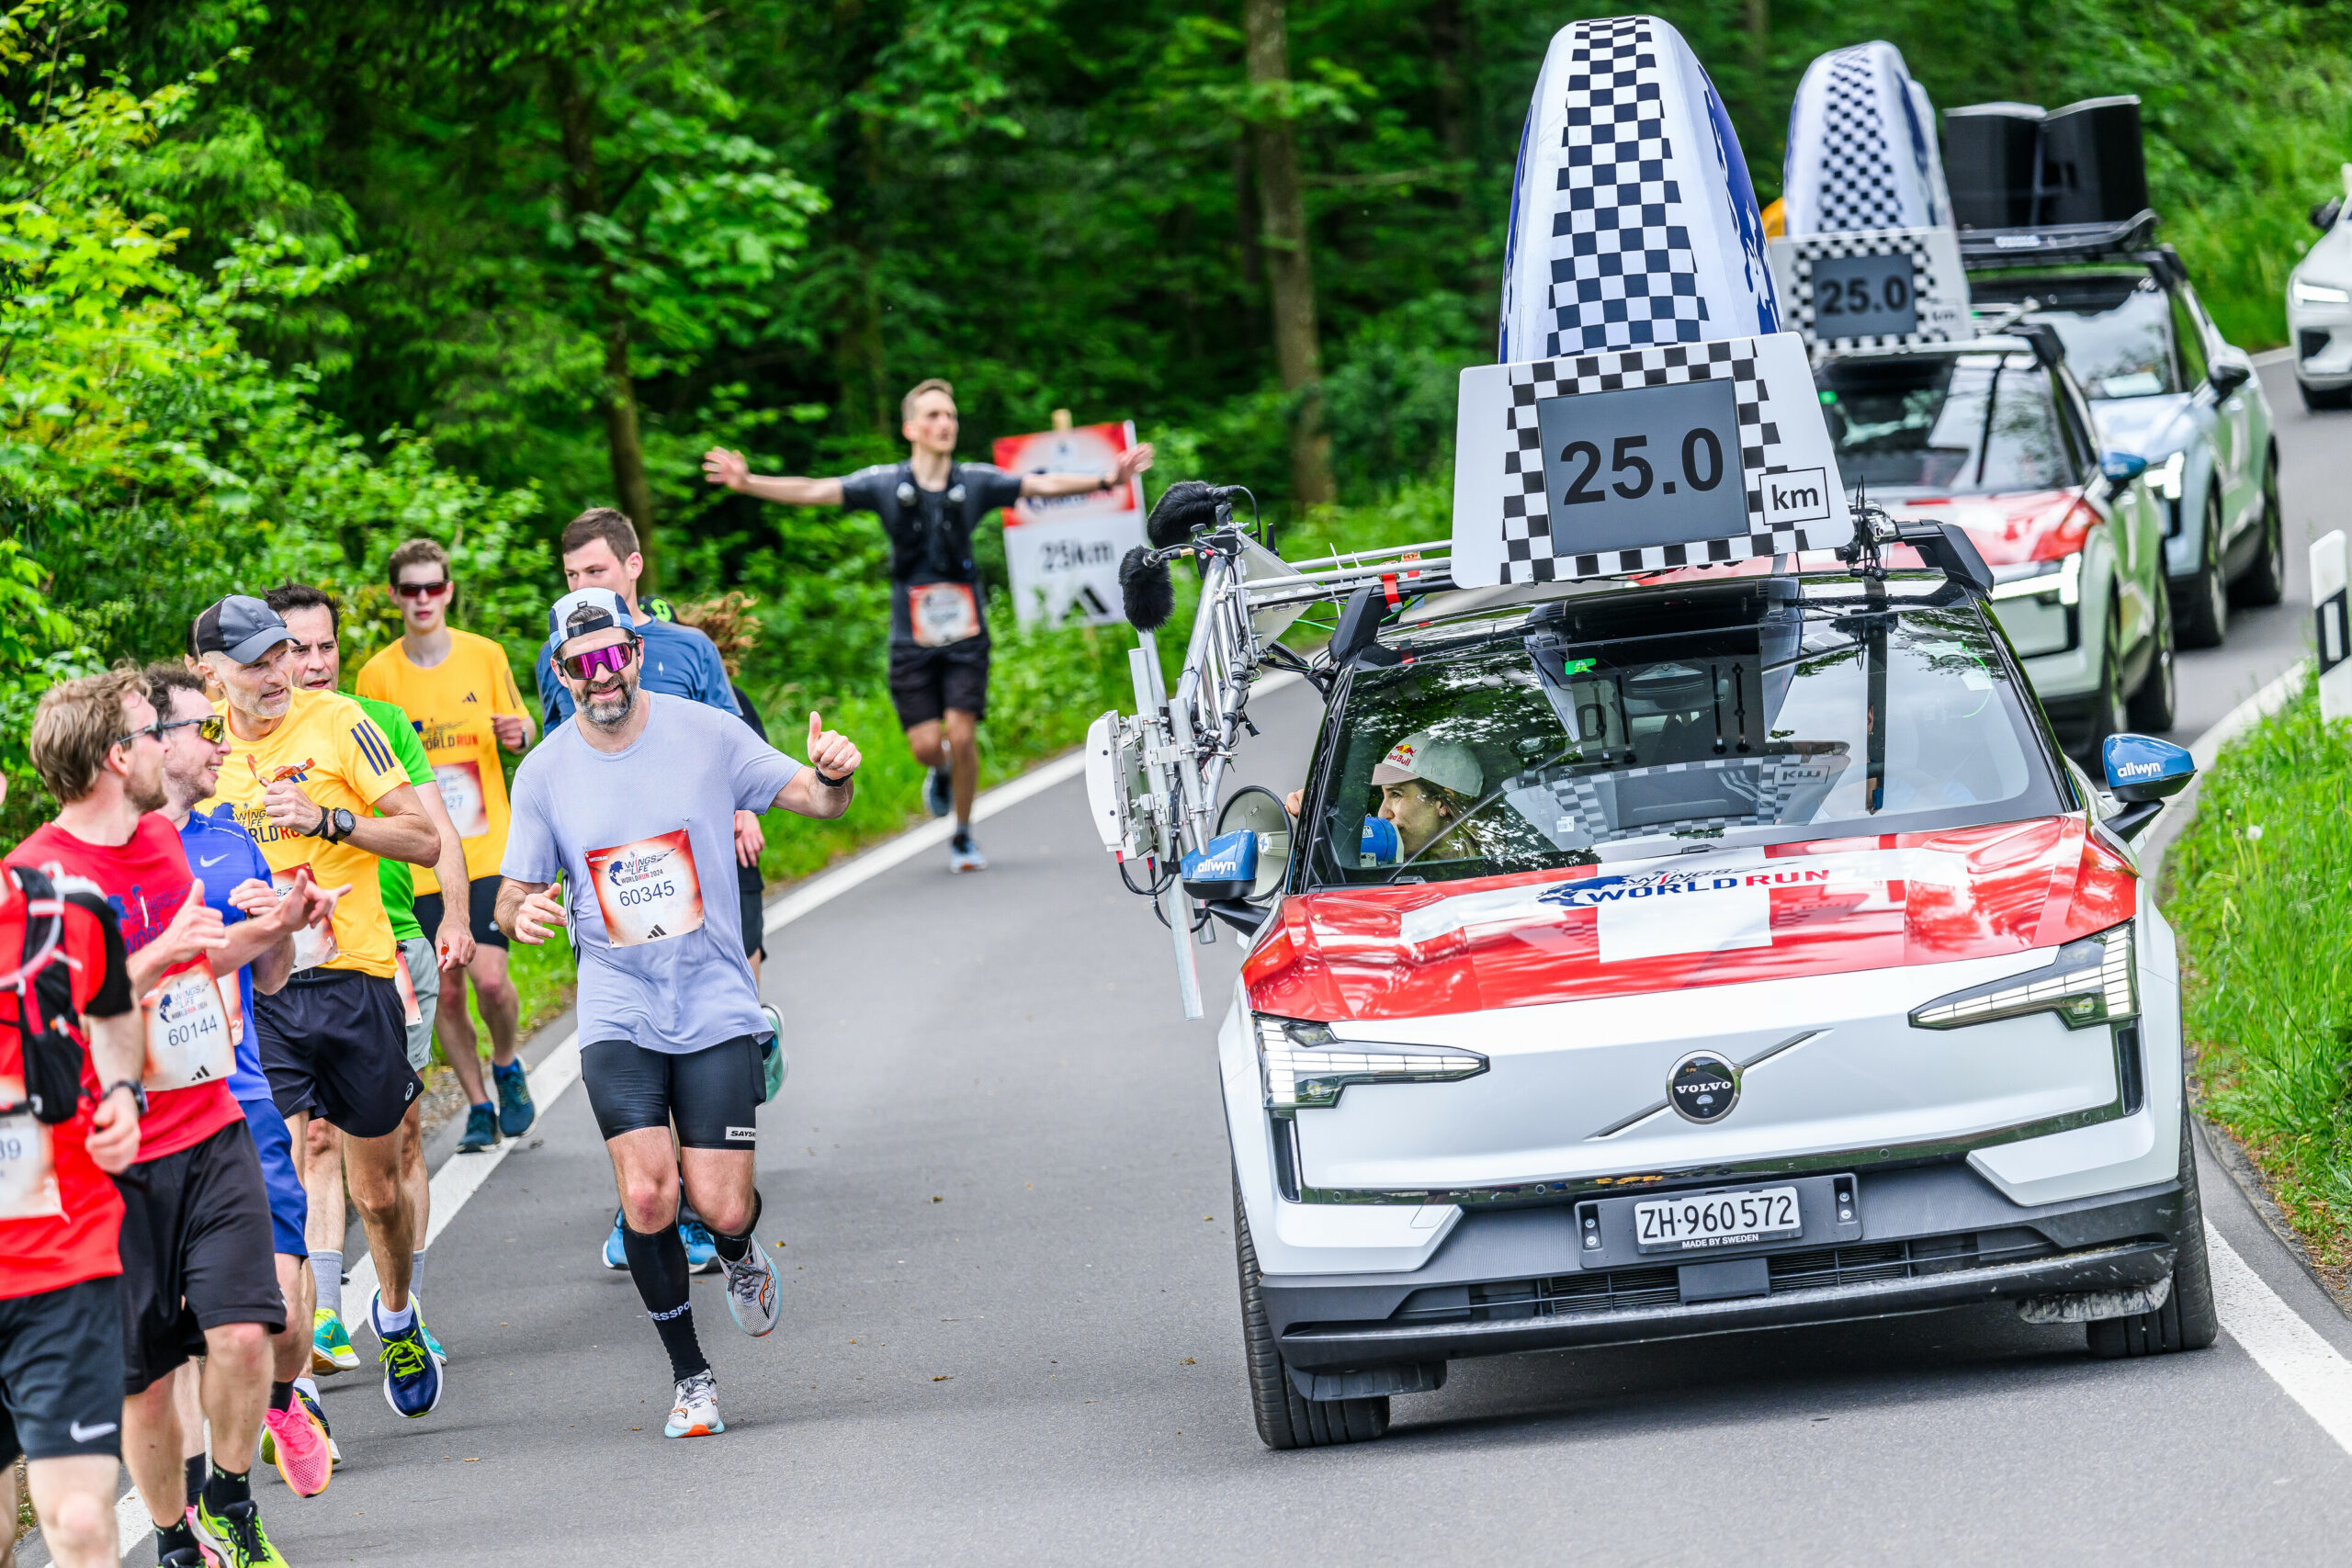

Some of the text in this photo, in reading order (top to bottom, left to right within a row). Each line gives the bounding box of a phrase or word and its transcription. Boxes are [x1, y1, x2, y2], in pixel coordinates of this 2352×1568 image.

[1818, 275, 1908, 317] 25.0
[1560, 427, 1724, 505] 25.0
[1770, 483, 1819, 511] km
[2117, 761, 2161, 778] allwyn
[234, 809, 270, 821] WING
[624, 855, 657, 869] WINGS
[1197, 858, 1237, 875] allwyn
[619, 880, 675, 907] 60345
[168, 1014, 218, 1046] 60144
[1675, 1080, 1732, 1094] VOLVO
[1740, 1195, 1794, 1228] 572
[1682, 1234, 1759, 1249] MADE BY SWEDEN
